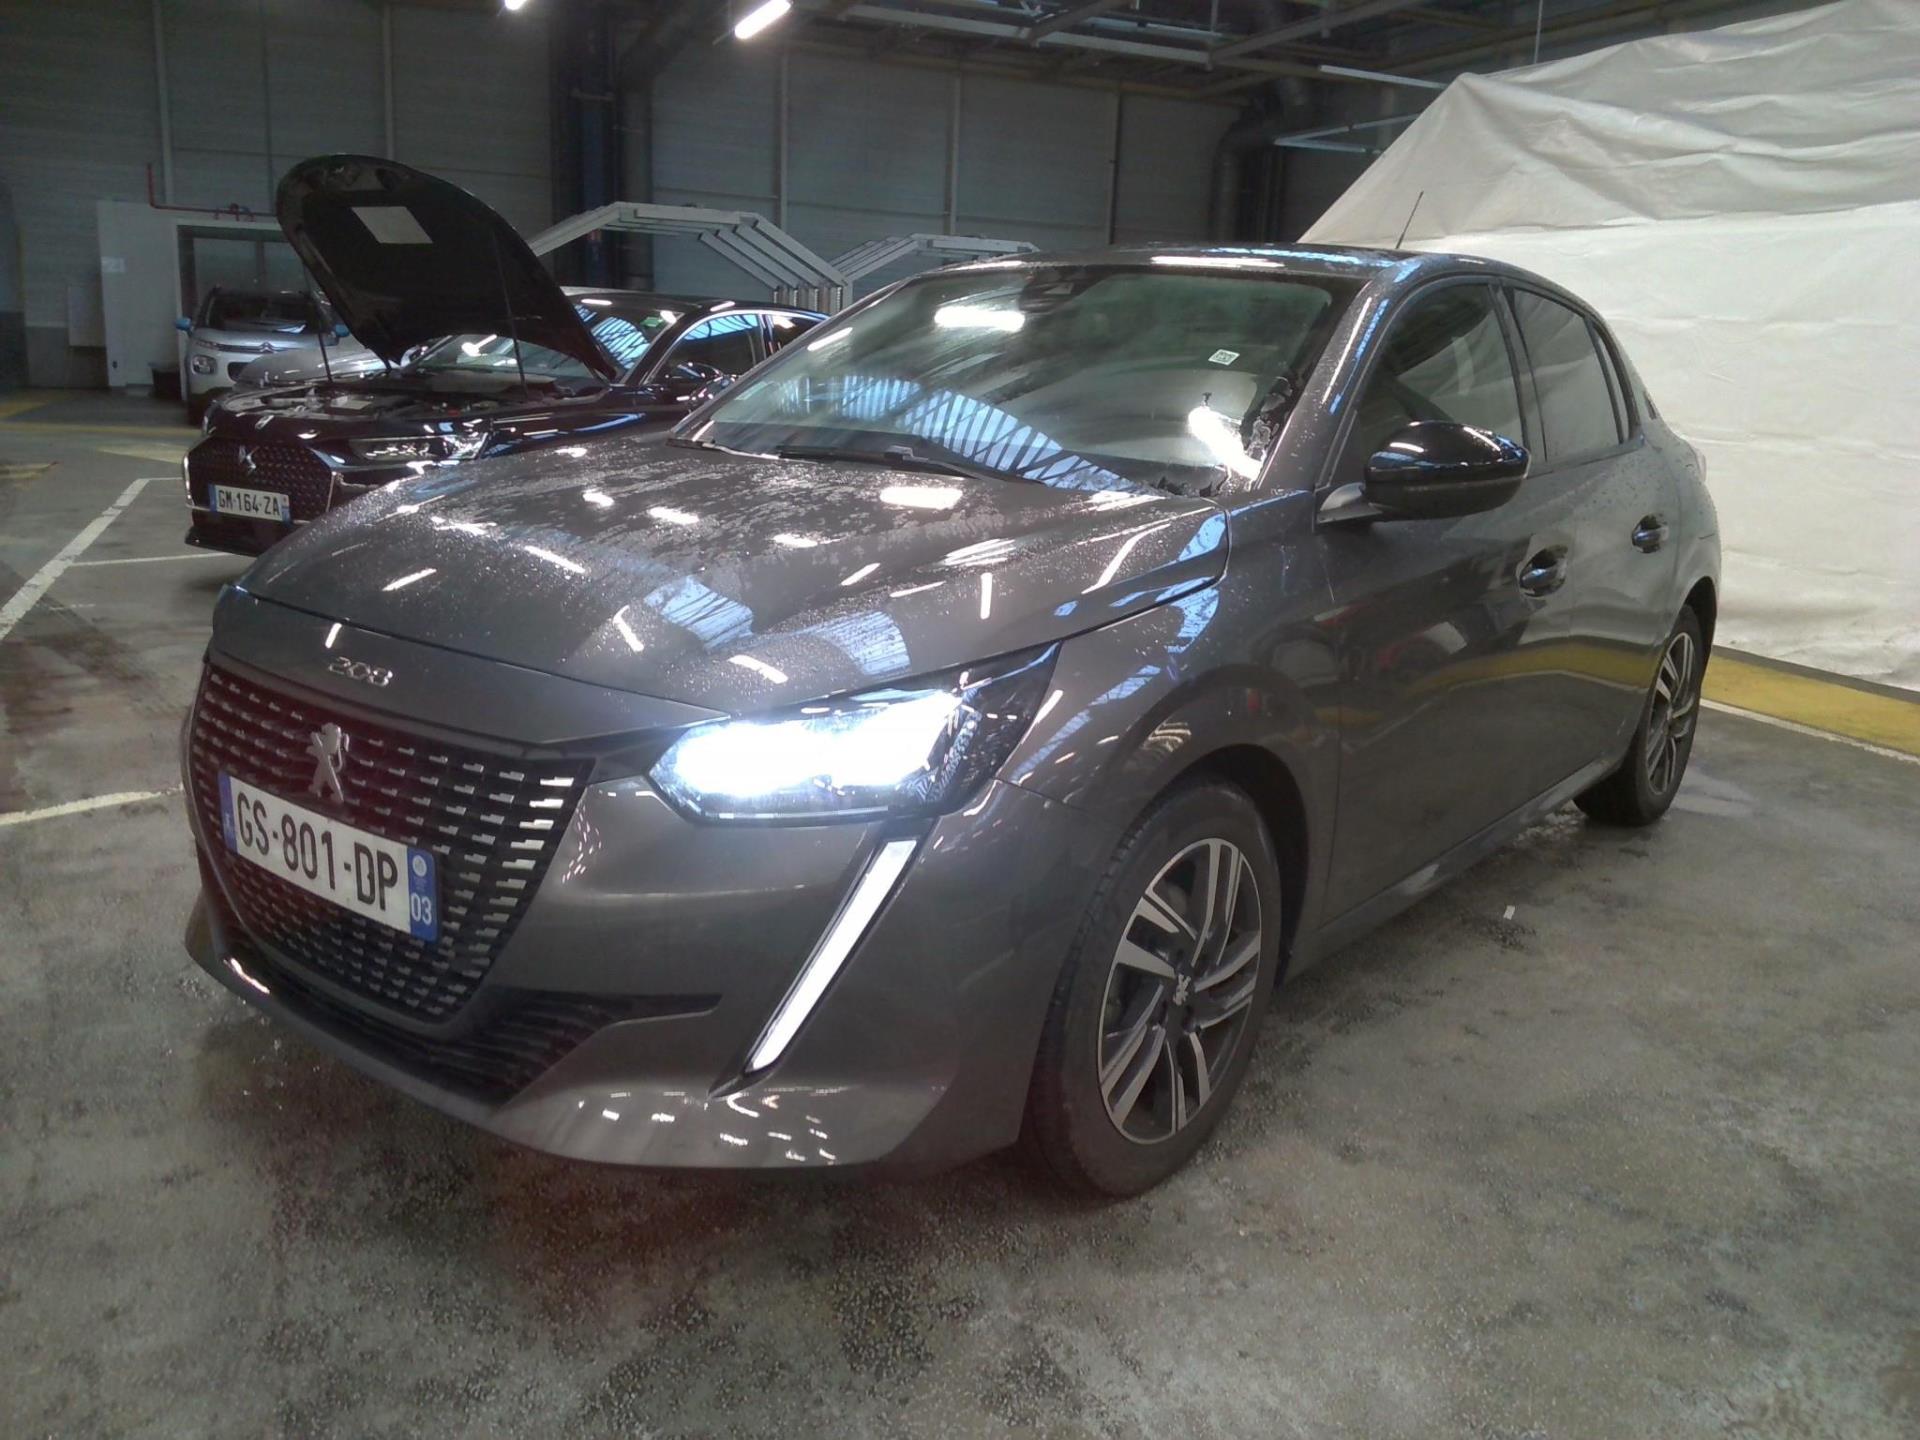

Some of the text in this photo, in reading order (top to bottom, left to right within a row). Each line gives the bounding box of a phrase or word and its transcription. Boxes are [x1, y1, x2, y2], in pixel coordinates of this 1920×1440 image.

[219, 490, 280, 516] GM-164-ZA
[328, 656, 393, 687] 208
[237, 791, 398, 911] GS-801-DP
[410, 892, 432, 925] 03
